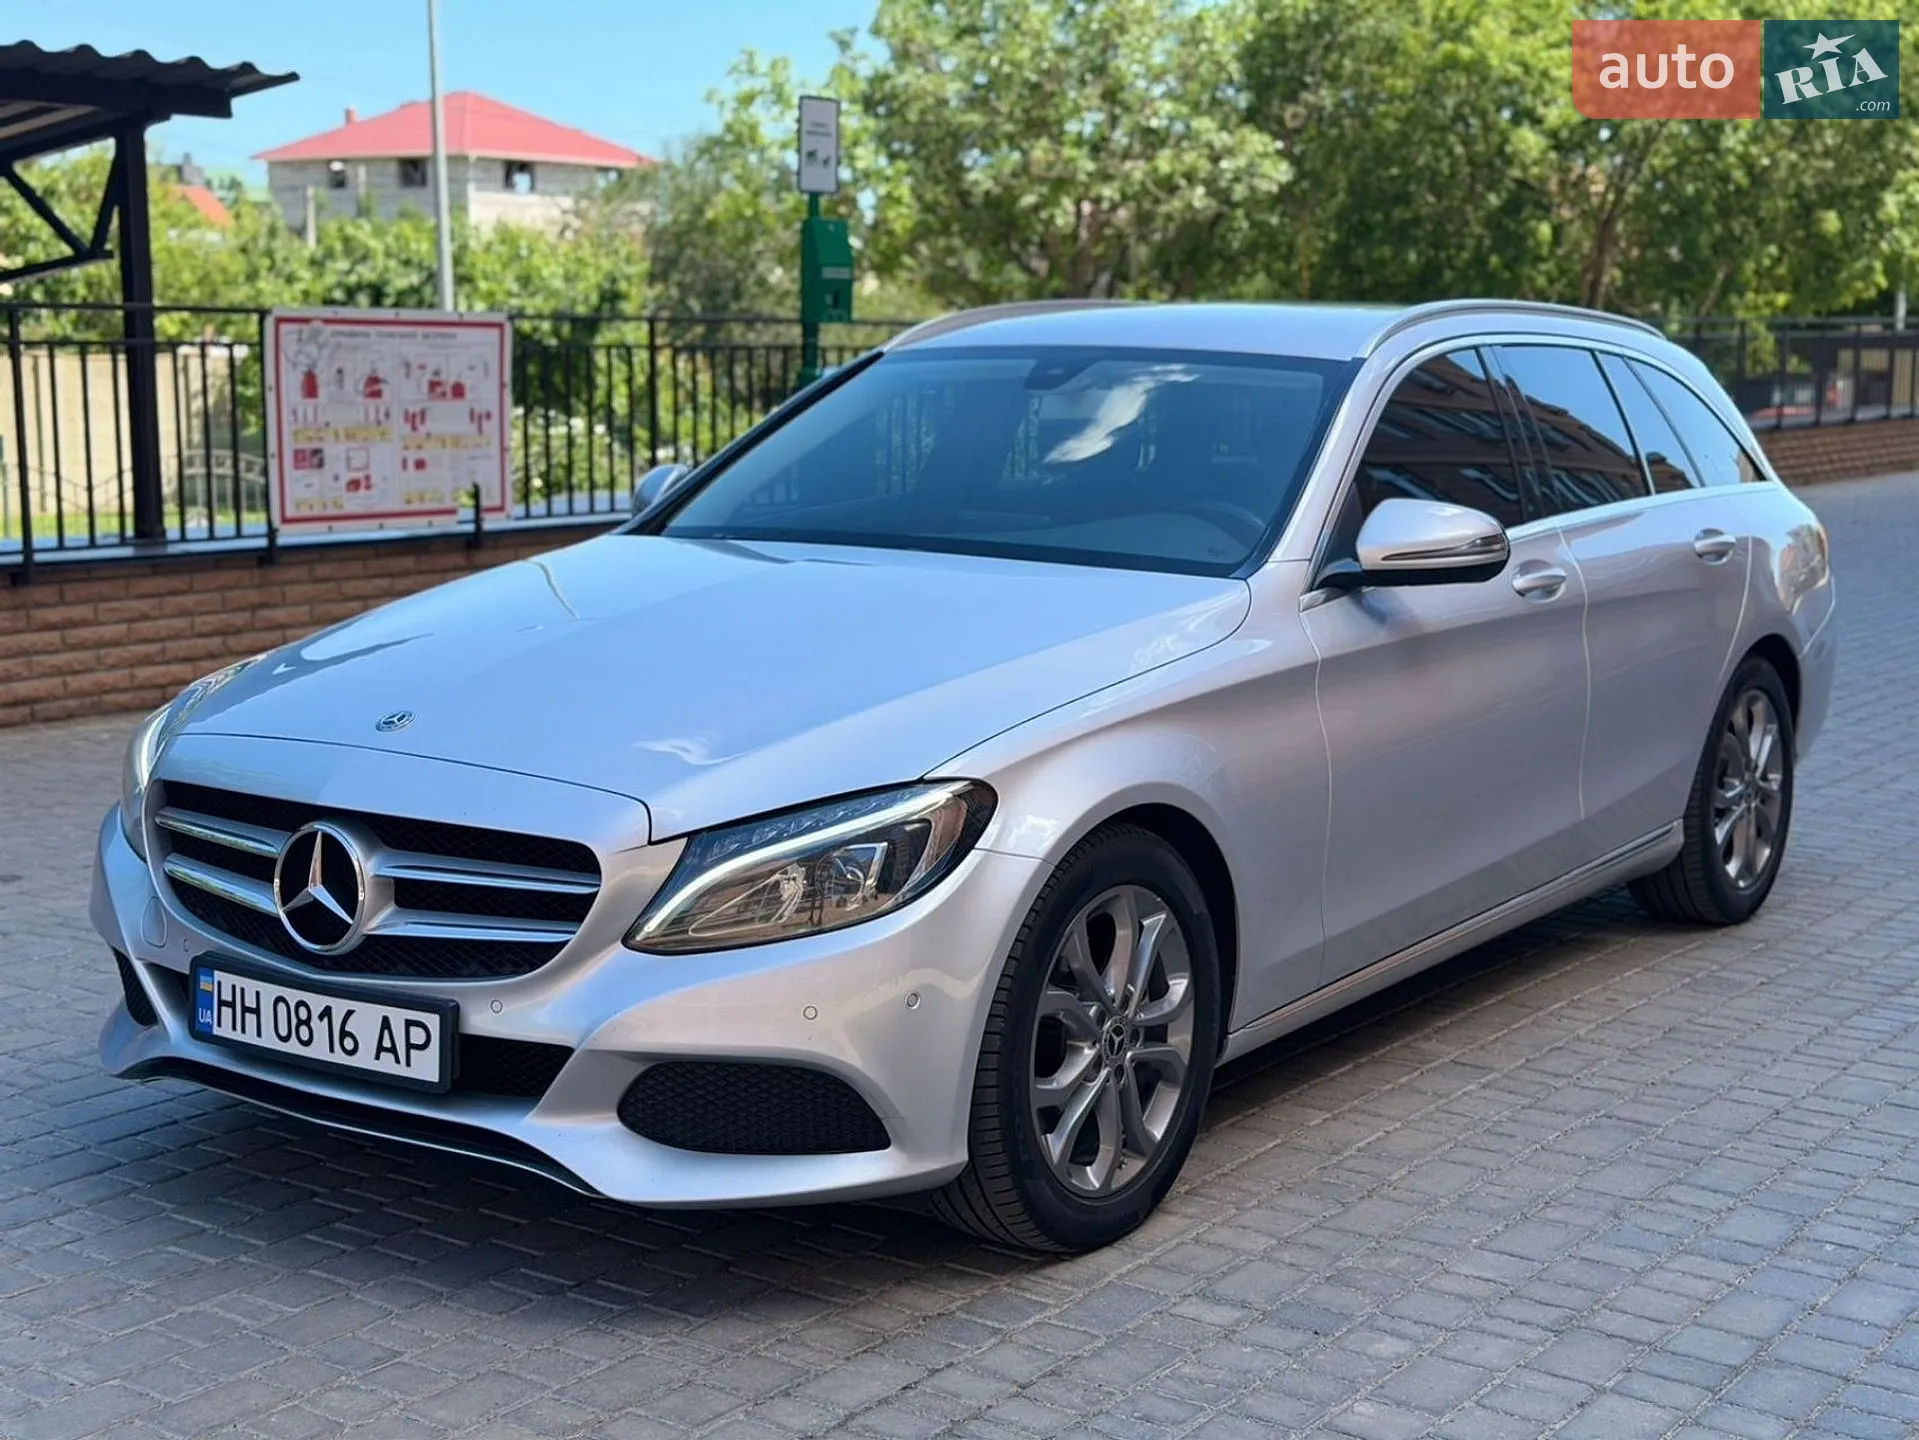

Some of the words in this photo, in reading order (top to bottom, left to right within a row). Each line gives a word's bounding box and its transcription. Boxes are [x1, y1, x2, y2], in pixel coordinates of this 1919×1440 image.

[198, 1008, 213, 1025] UA
[217, 980, 262, 1038] HH
[272, 995, 360, 1057] 0816
[374, 1014, 432, 1068] AP
